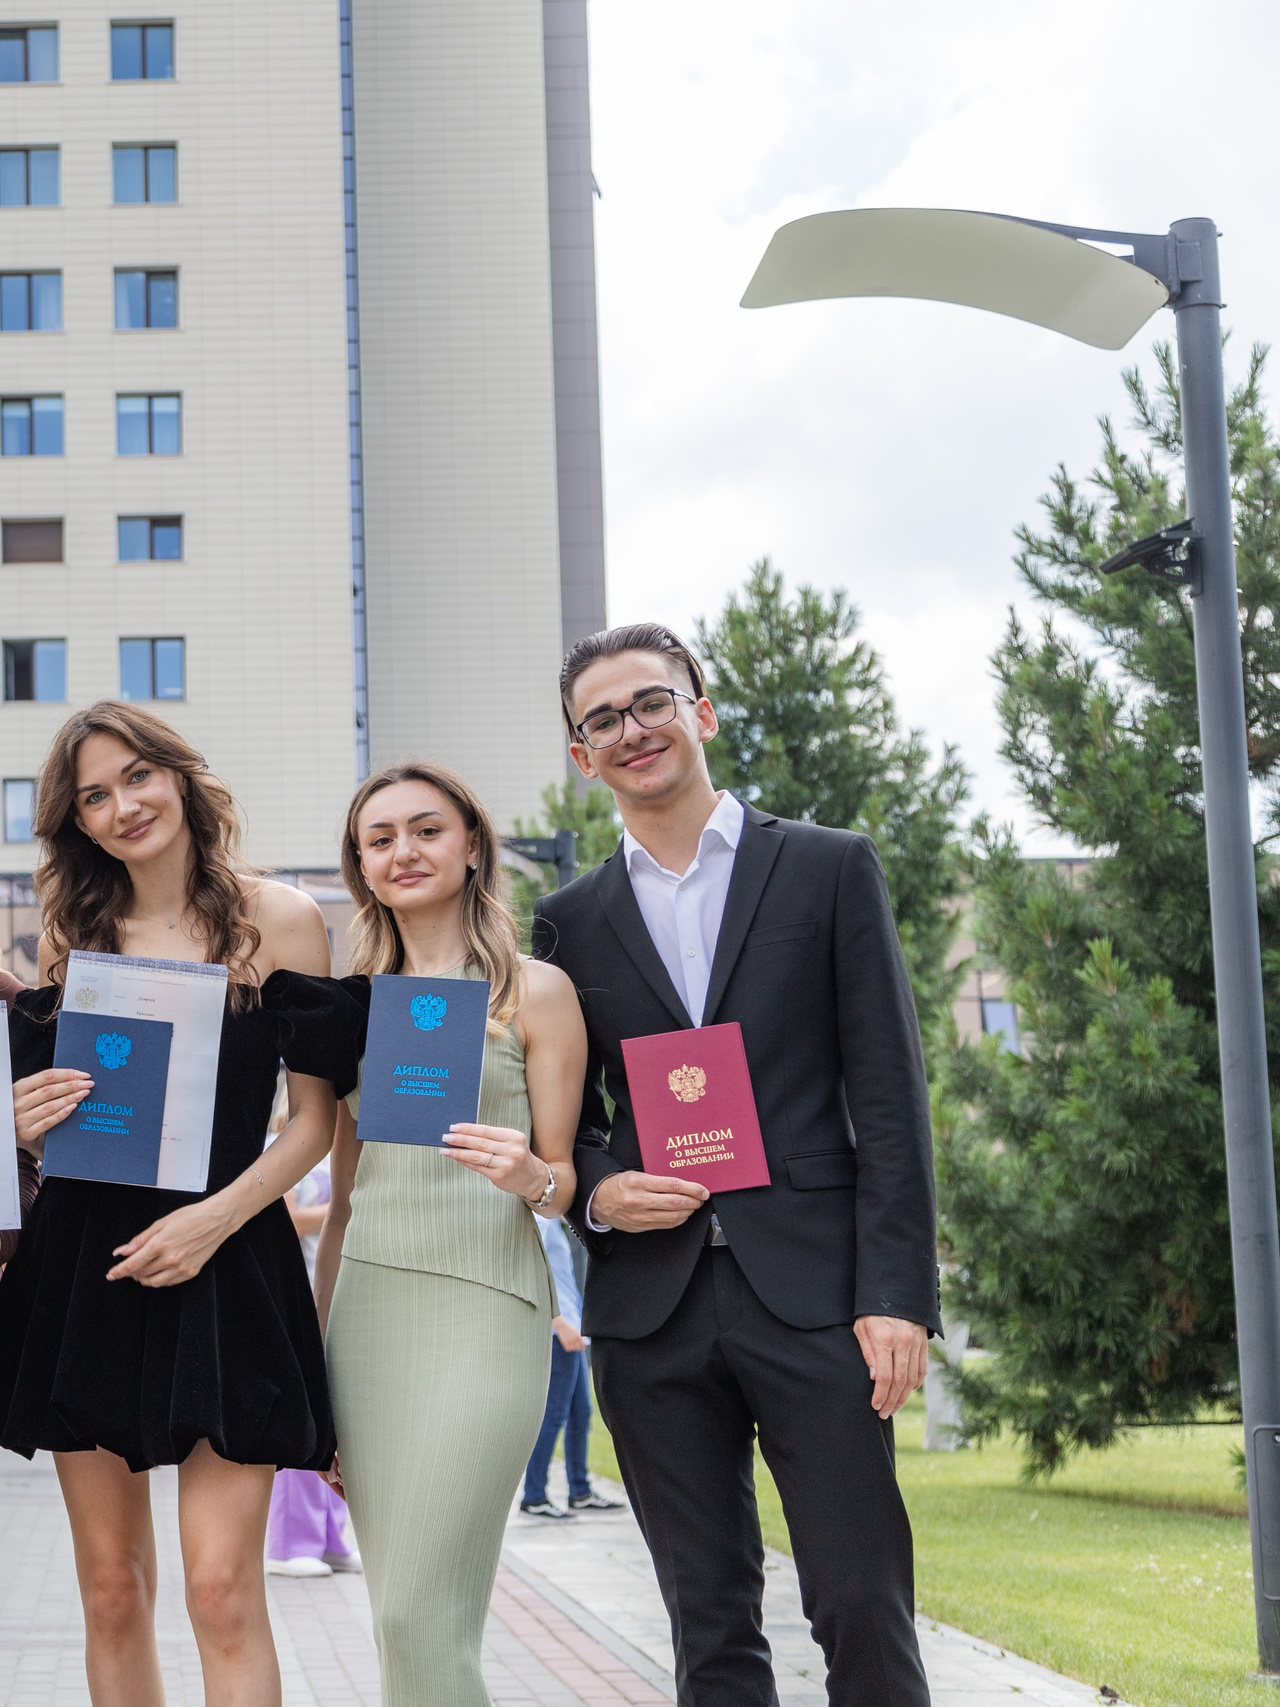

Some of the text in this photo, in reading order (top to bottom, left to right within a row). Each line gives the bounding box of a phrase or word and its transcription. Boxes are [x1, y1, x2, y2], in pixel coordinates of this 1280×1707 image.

[393, 1064, 449, 1078] ДИПЛОМ
[407, 1080, 440, 1088] ВЫСШЕМ
[394, 1087, 446, 1097] ОБРАЗОВАНИИ
[78, 1101, 133, 1116] ДИПЛОМ
[93, 1117, 124, 1126] ВЫСШЕМ
[79, 1124, 129, 1135] ОБРАЗОВАНИИ
[666, 1127, 734, 1151] ДИПЛОМ
[675, 1143, 726, 1158] О ВЫСШЕМ
[669, 1152, 735, 1169] ОБРАЗОВАНИИ
